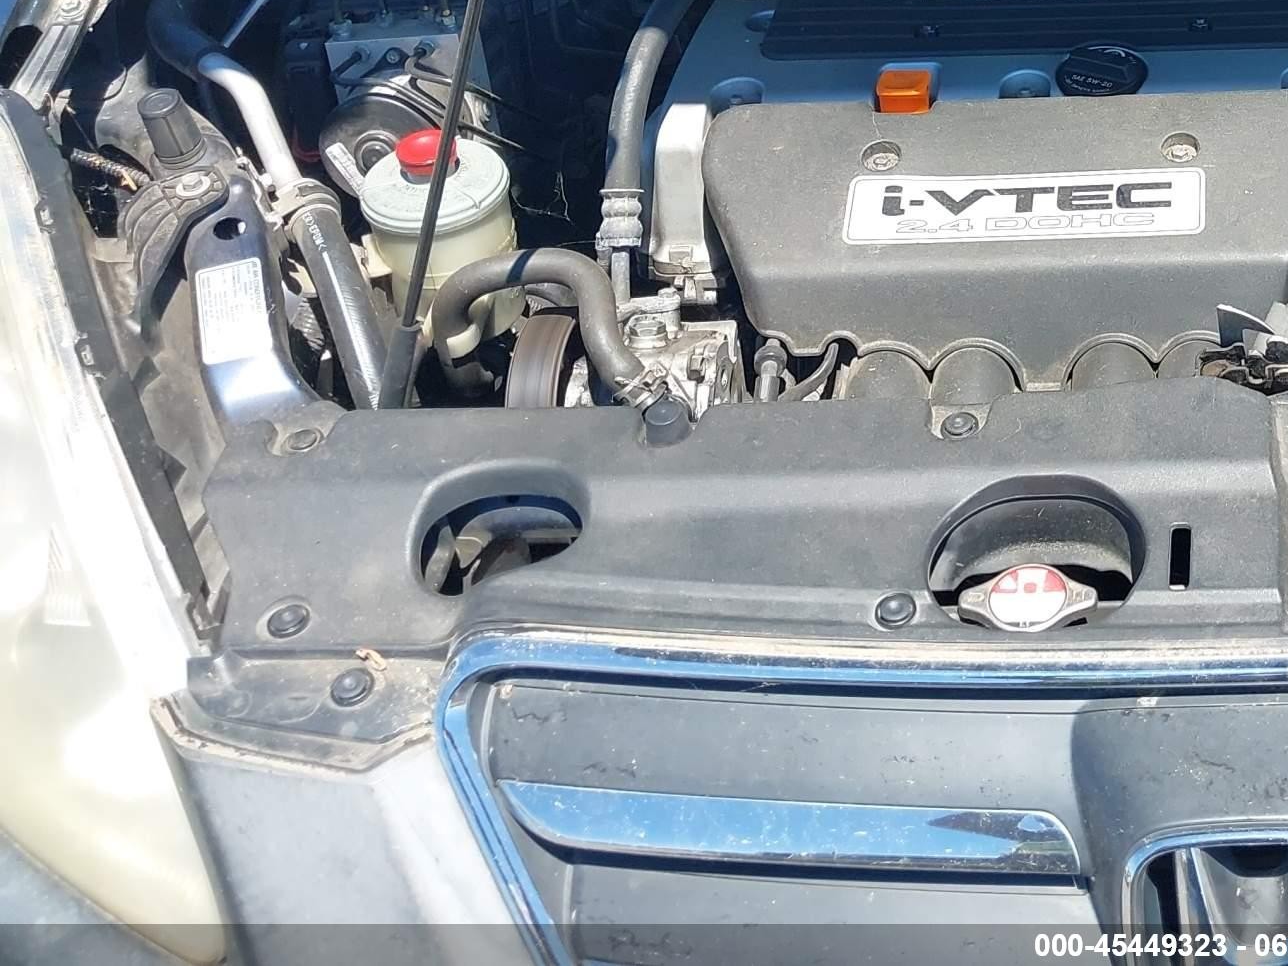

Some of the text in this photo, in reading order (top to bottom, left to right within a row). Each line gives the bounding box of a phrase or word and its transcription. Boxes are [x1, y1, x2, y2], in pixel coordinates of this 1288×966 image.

[882, 182, 1172, 216] i-VTEC
[896, 212, 1155, 233] 2.4 DOHC
